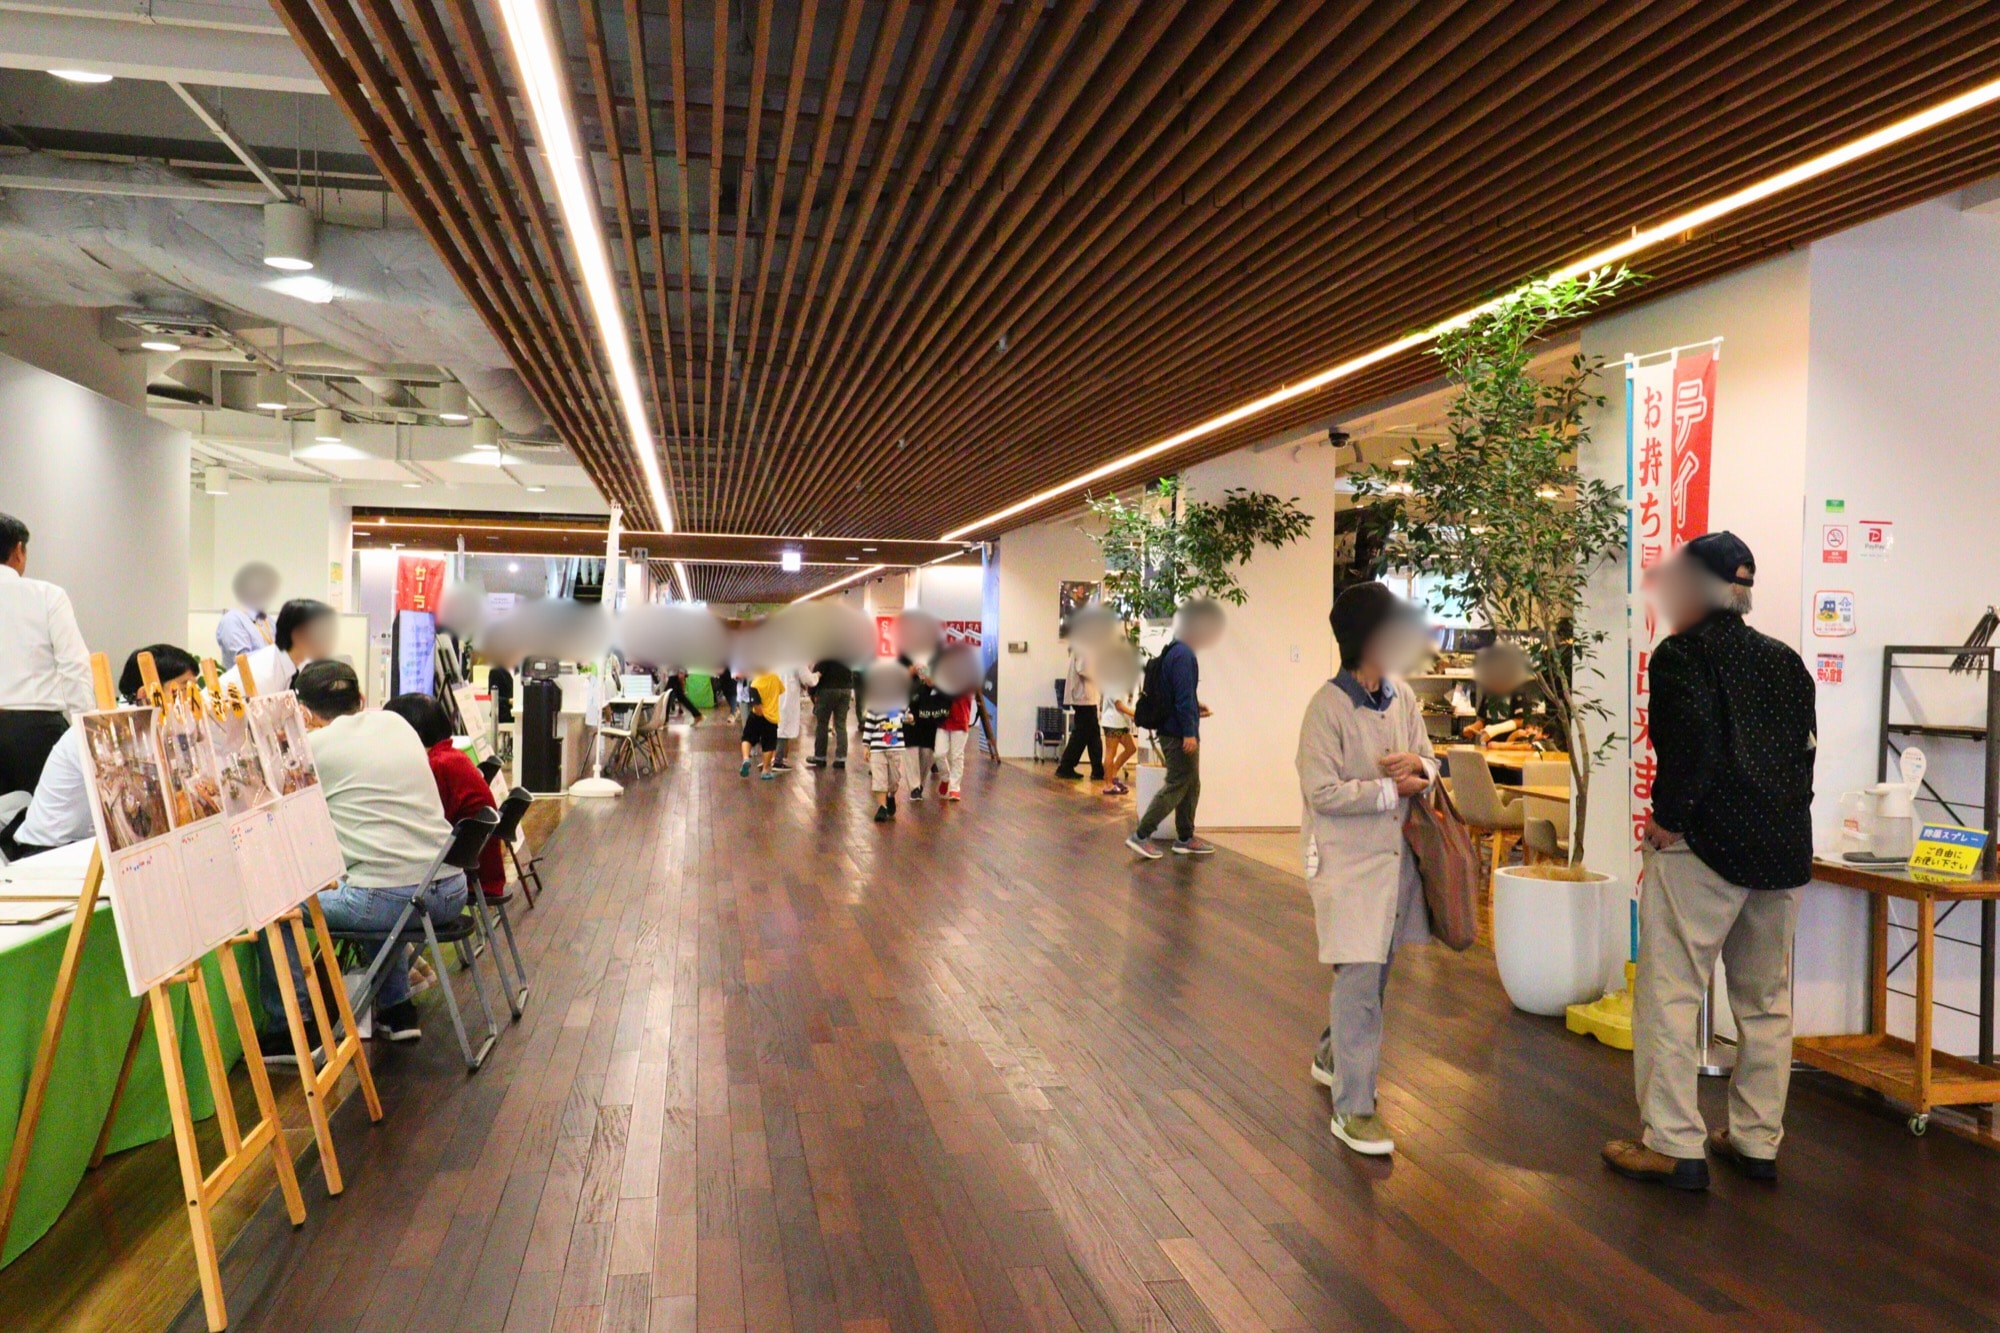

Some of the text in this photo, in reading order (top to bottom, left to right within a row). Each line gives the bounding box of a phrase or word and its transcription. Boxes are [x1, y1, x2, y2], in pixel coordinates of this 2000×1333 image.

[1672, 378, 1707, 548] テイ
[1923, 828, 1979, 842] 除菌スプレー
[1926, 847, 1963, 859] ご自由に
[1914, 855, 1968, 870] お使い下さい
